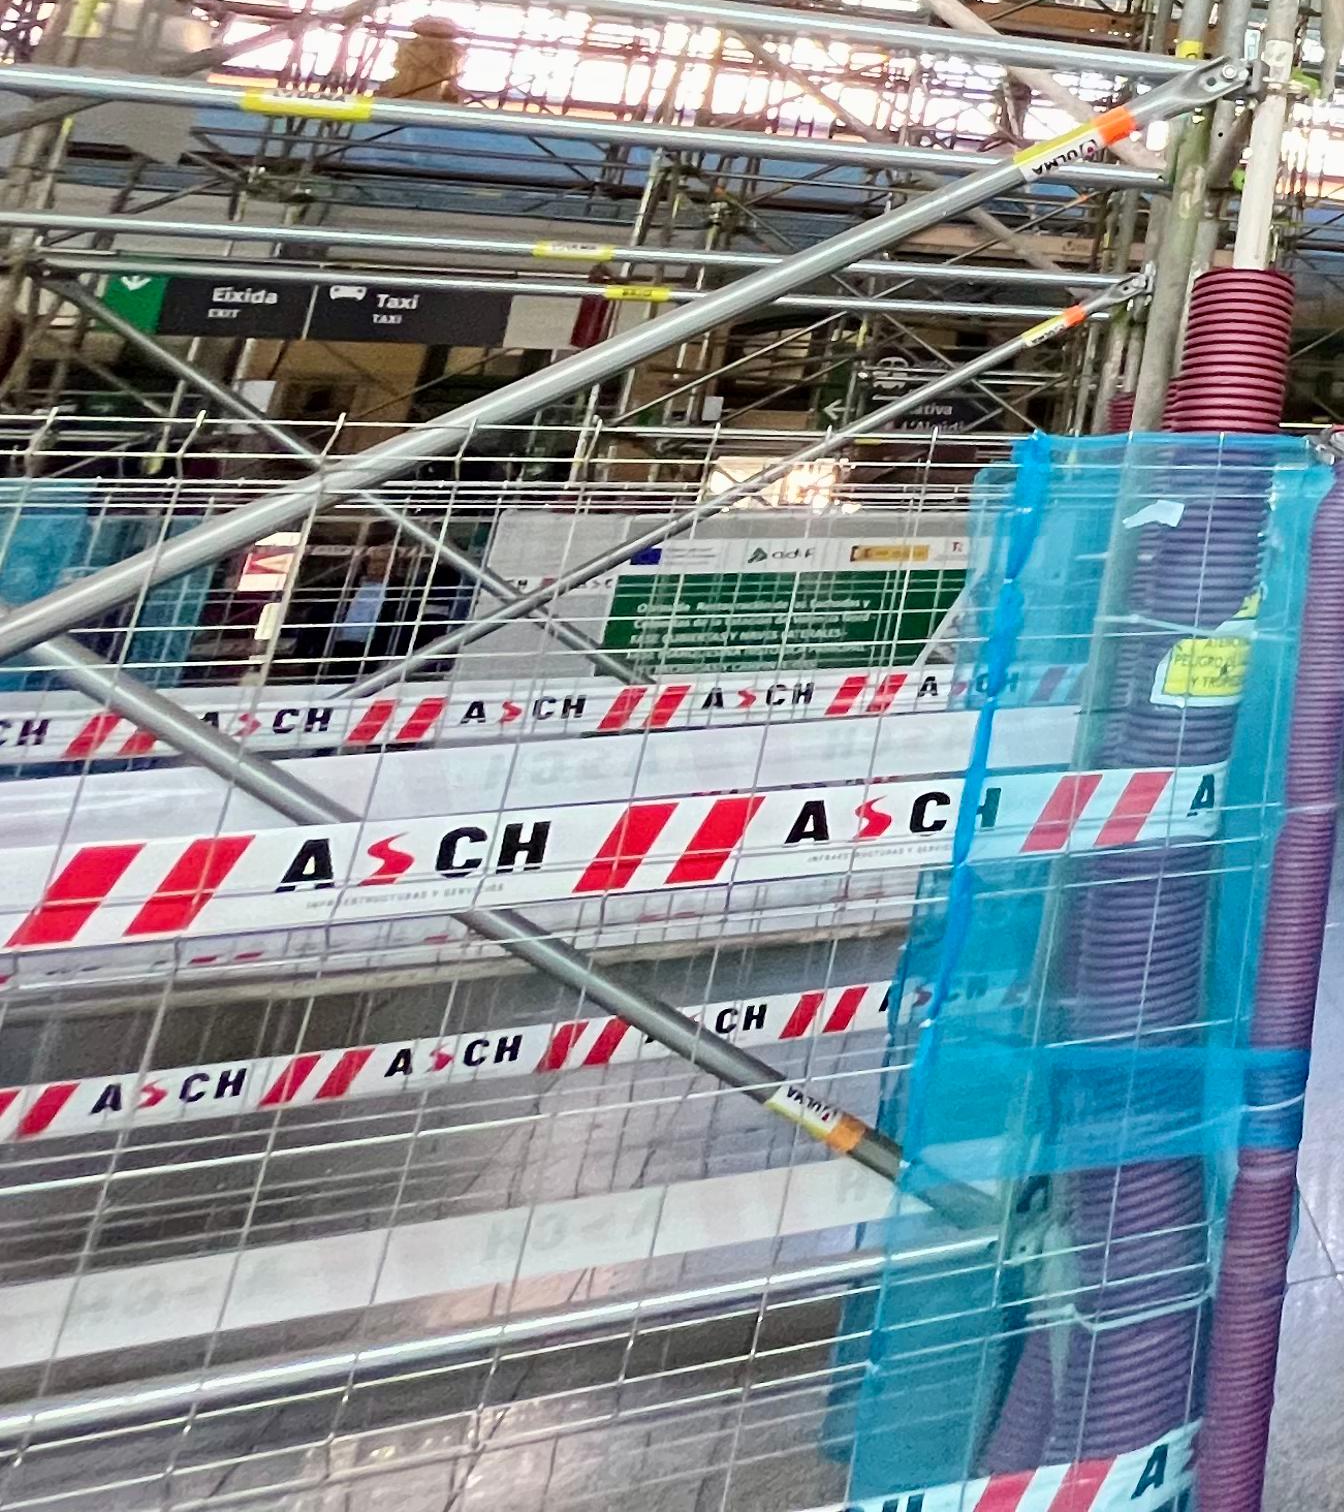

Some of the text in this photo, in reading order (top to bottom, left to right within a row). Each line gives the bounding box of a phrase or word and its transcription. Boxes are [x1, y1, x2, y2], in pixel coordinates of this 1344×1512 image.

[213, 286, 278, 305] Eixida
[377, 294, 420, 310] Taxi
[373, 314, 403, 325] TAXI
[460, 695, 588, 725] ASCH
[702, 682, 815, 711] ASCH
[275, 820, 552, 893] ASCH
[90, 1068, 248, 1115] ASCH
[384, 1035, 524, 1079] ASCH
